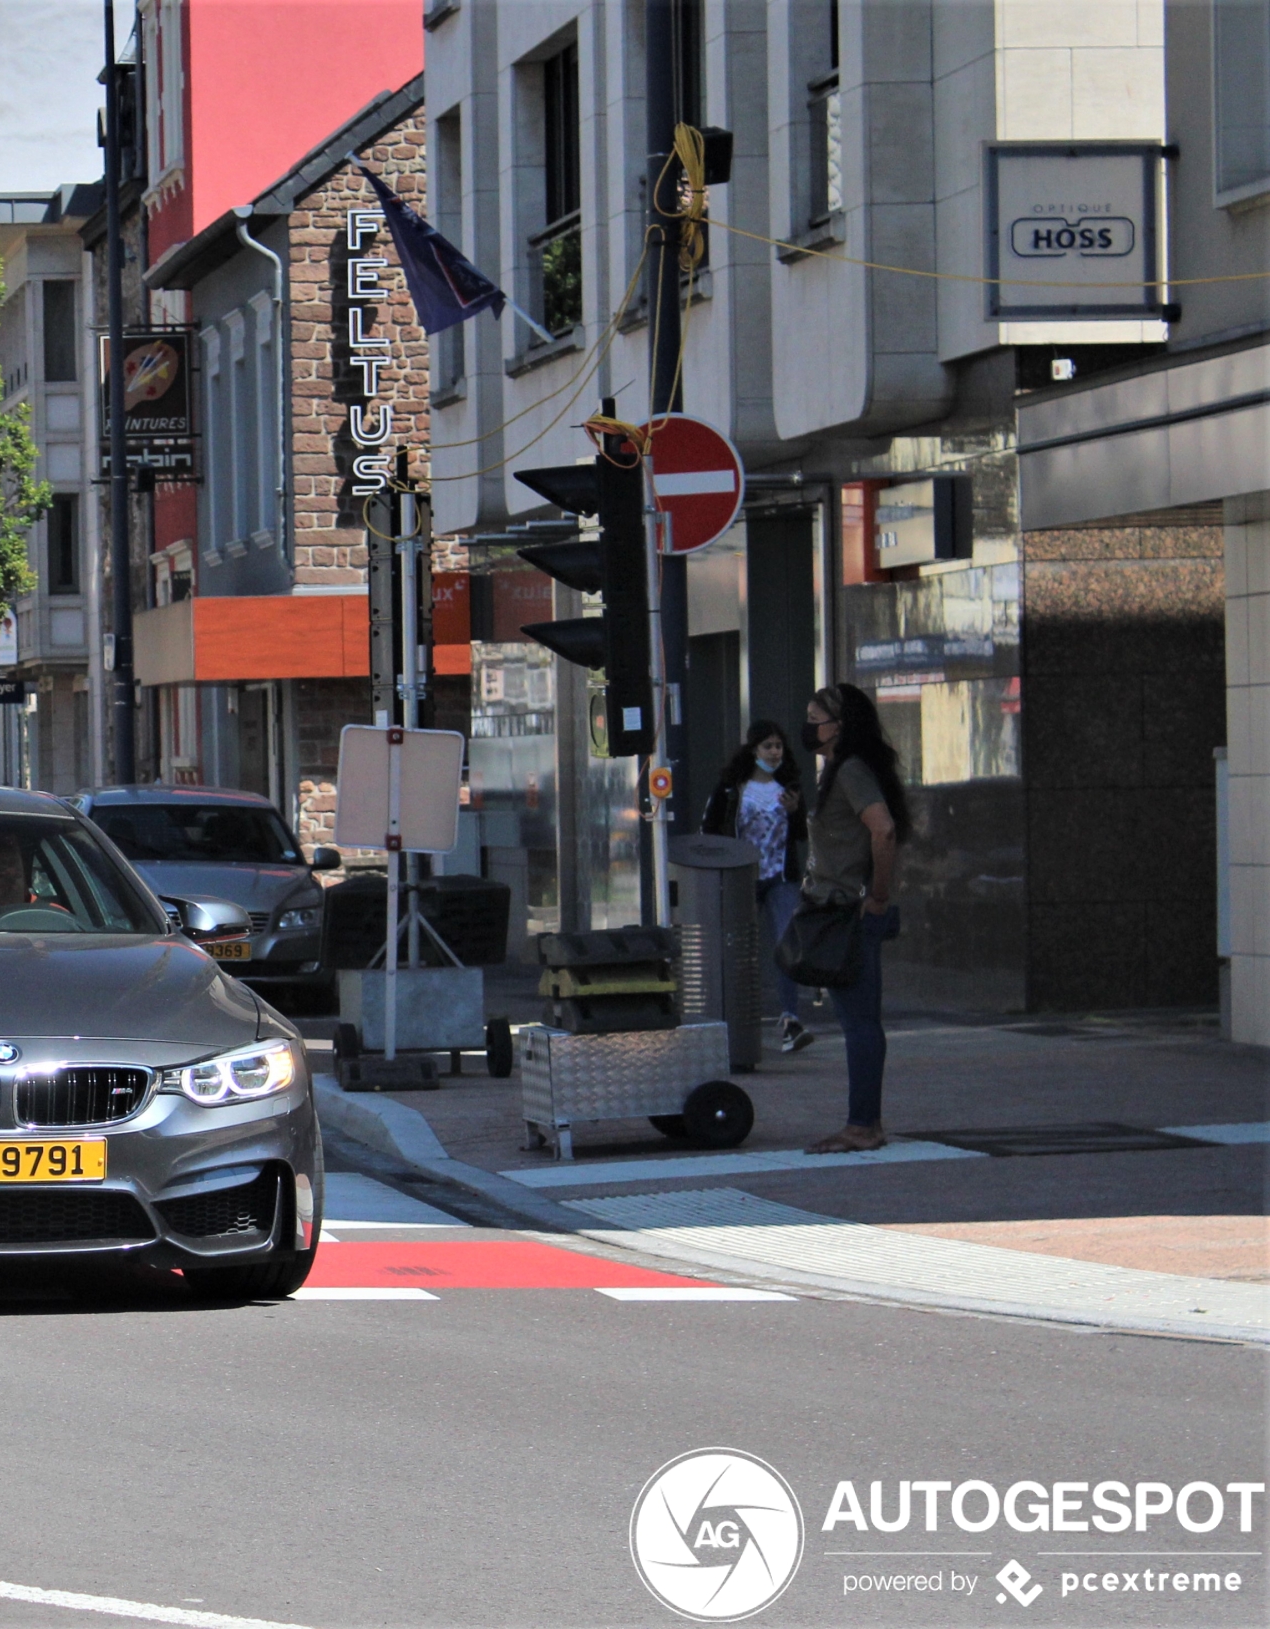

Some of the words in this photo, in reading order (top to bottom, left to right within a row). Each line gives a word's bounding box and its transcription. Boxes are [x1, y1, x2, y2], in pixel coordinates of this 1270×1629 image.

[1033, 228, 1113, 249] HOSS
[347, 209, 391, 496] FELTUS
[2, 1145, 84, 1176] 9791
